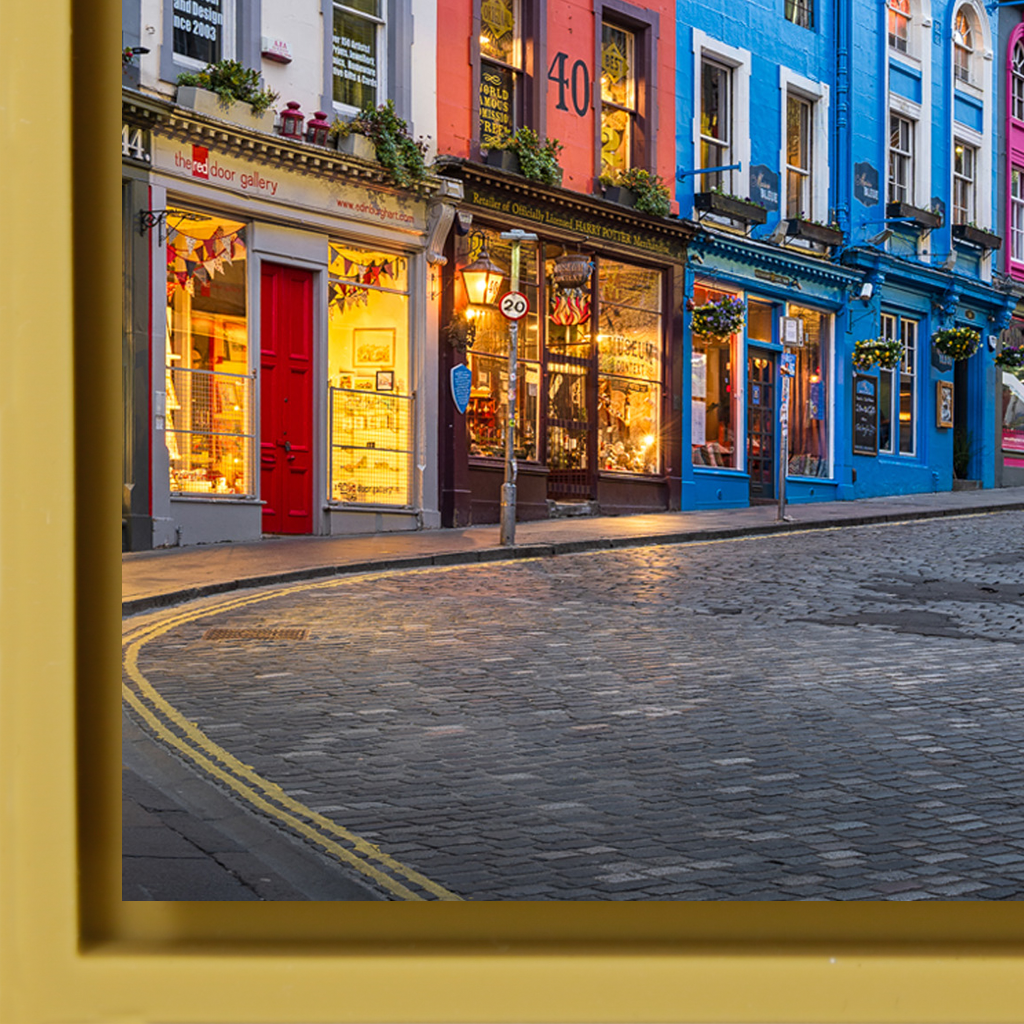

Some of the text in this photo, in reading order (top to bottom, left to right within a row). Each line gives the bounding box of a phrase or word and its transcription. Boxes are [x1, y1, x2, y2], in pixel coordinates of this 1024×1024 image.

[192, 1, 223, 25] Design
[193, 20, 217, 41] 2003
[547, 51, 590, 118] 40
[174, 150, 279, 196] the red door gallery
[473, 192, 501, 210] Retailer
[502, 201, 511, 212] of
[511, 203, 545, 222] Officially
[574, 220, 601, 236] HARRY
[602, 227, 632, 244] POTTER
[503, 298, 526, 314] 20
